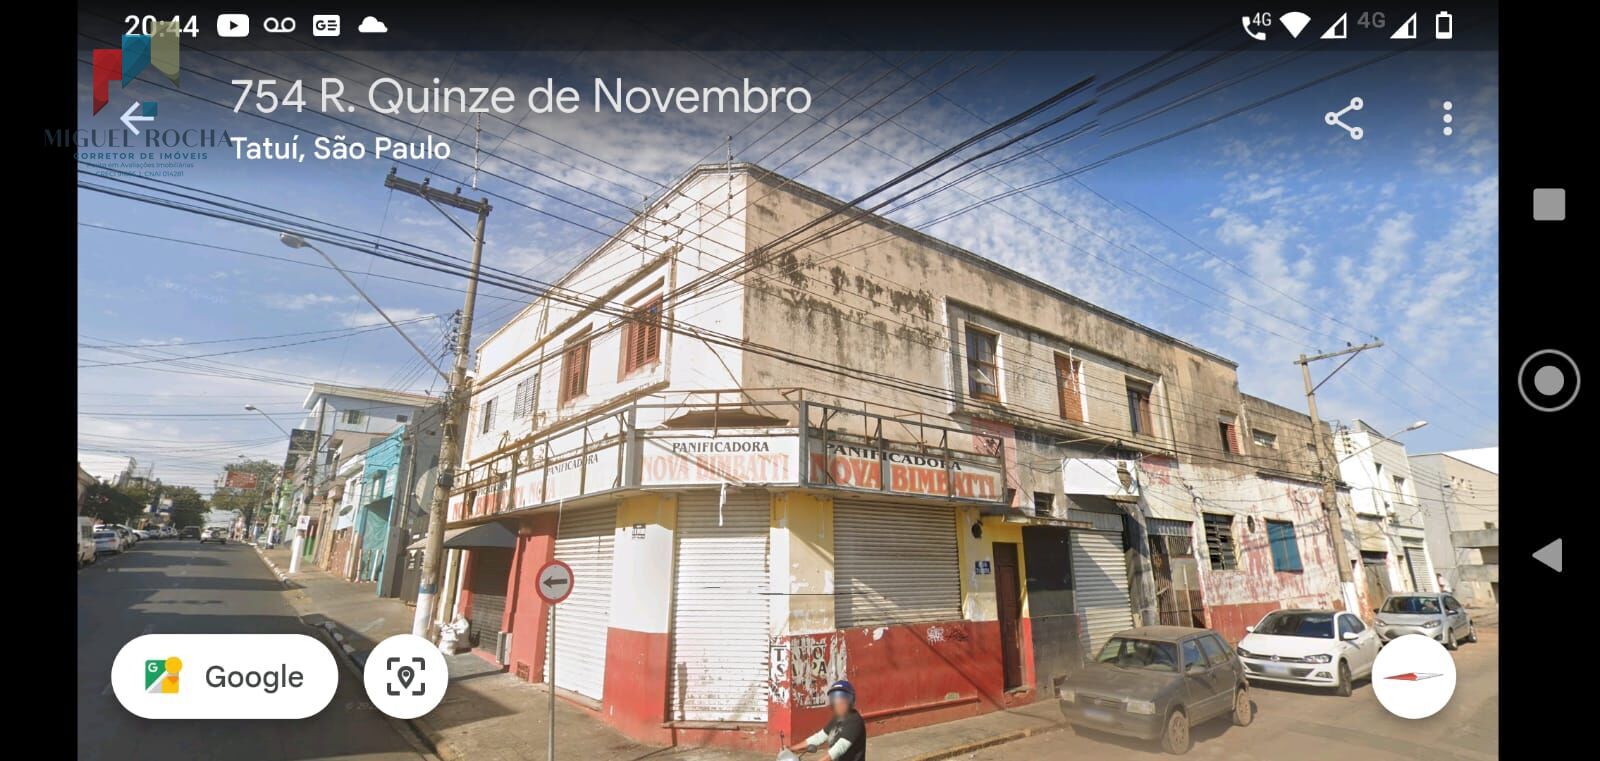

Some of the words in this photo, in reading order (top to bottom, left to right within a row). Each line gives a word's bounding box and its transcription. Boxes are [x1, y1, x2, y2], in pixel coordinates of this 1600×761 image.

[672, 441, 770, 453] PANIFICADORA
[642, 454, 689, 482] NOVA
[809, 452, 880, 489] NOVA
[891, 463, 997, 500] BIMBATTI
